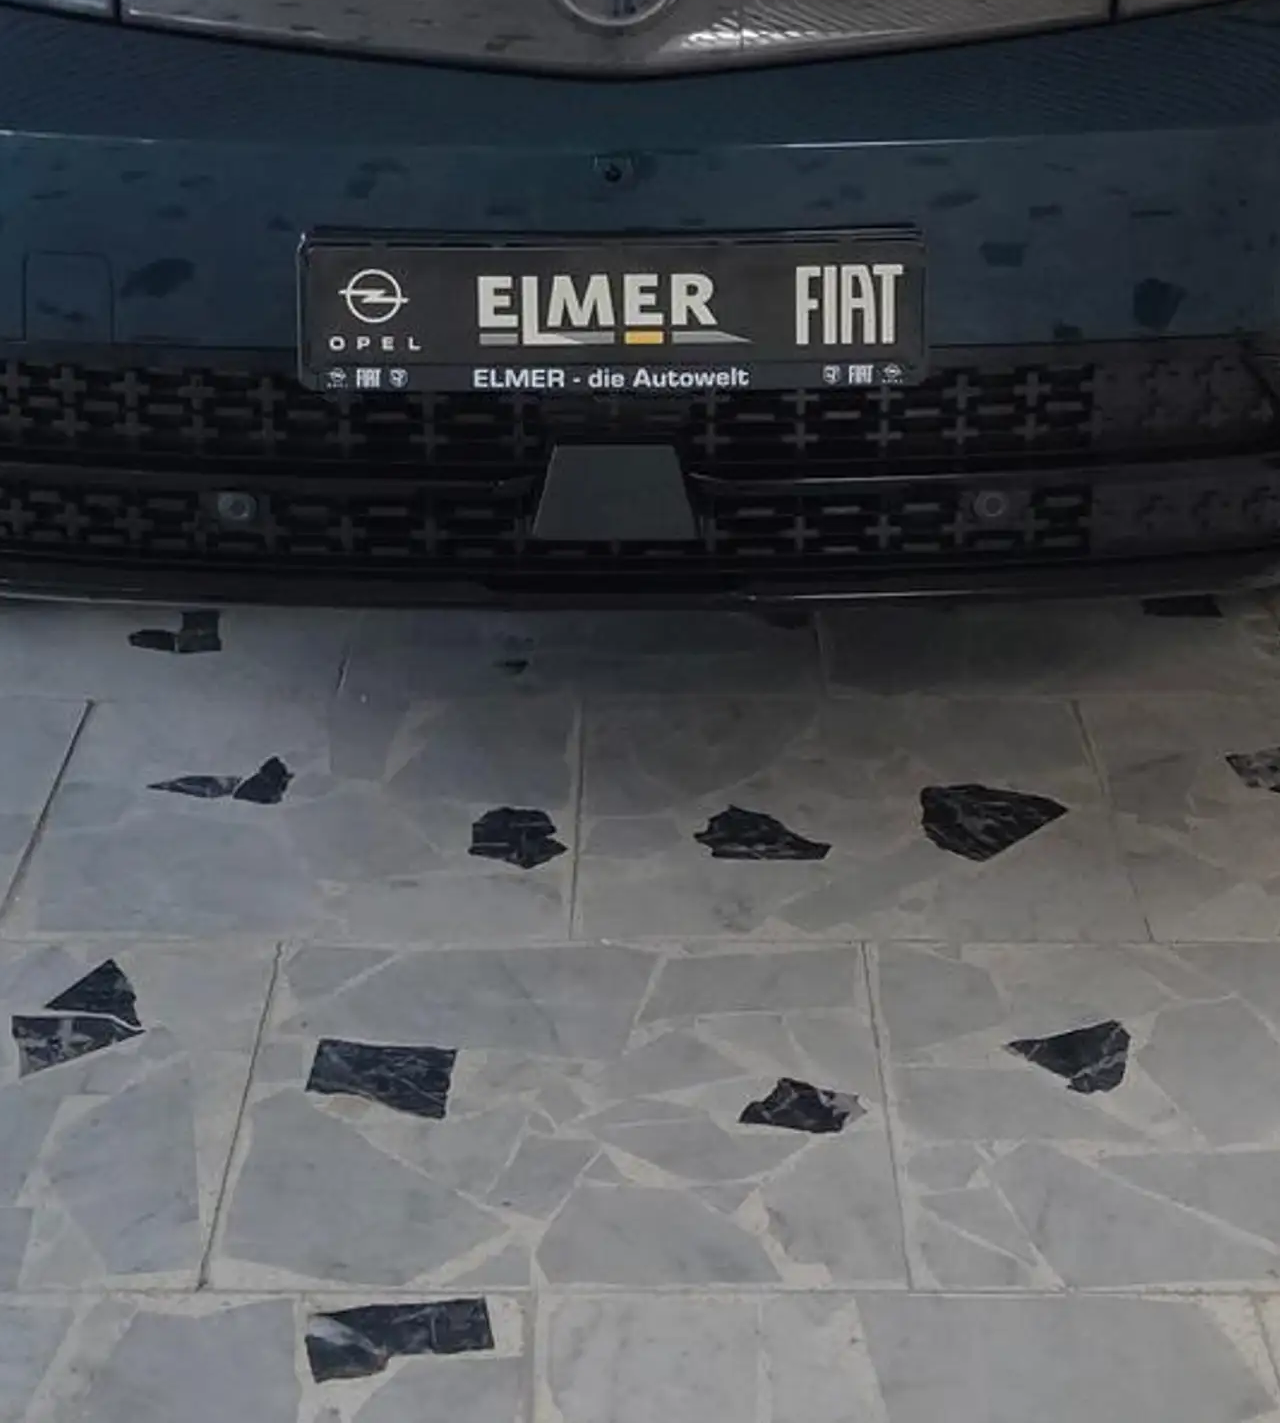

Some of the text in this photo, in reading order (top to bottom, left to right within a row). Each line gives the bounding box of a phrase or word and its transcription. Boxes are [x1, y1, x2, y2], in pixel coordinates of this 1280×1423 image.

[477, 273, 718, 345] ELMER
[795, 264, 904, 345] FIAT
[329, 336, 422, 351] OPEL
[474, 369, 565, 388] ELMER
[588, 368, 625, 388] die
[632, 367, 749, 388] Autowelt
